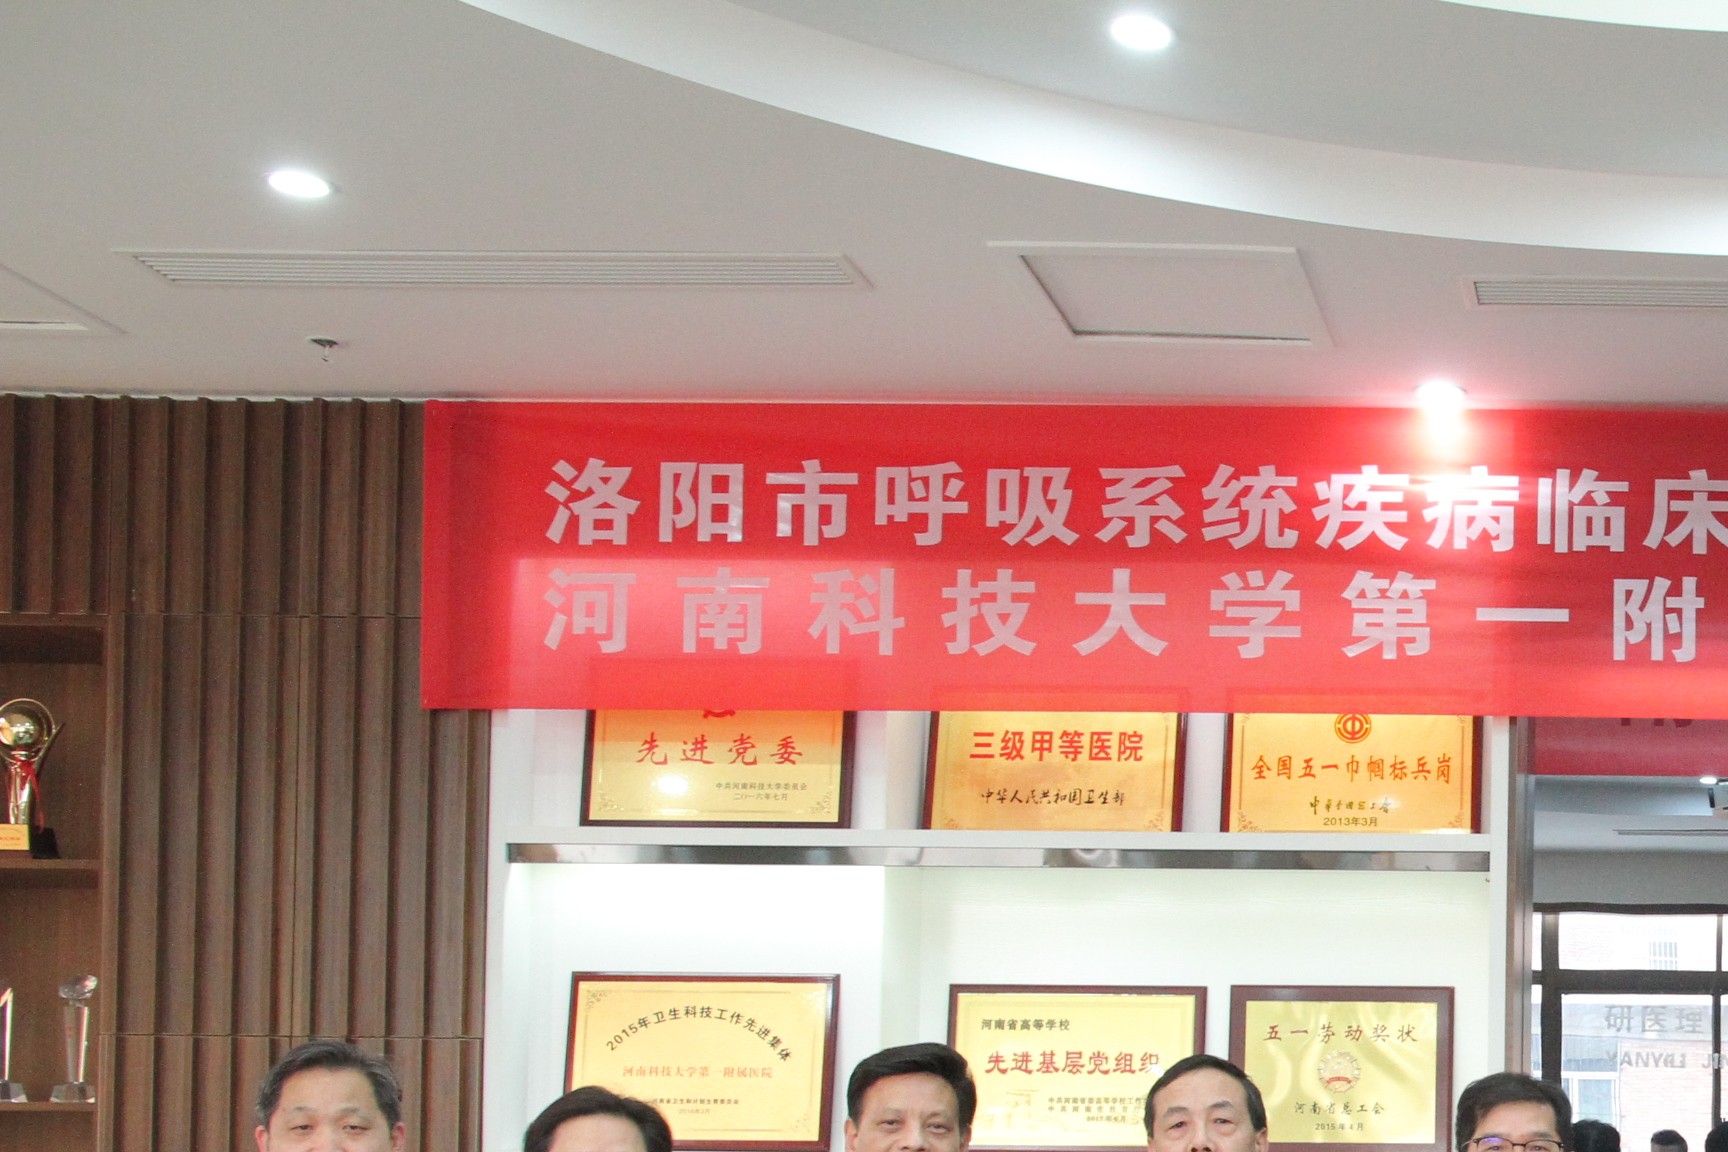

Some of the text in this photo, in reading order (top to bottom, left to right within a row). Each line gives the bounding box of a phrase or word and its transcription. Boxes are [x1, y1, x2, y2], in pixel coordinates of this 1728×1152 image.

[635, 730, 804, 766] 先进党委
[969, 729, 1144, 762] 三级甲等医院
[1250, 752, 1452, 784] 全国五一巾帼标兵岗
[981, 788, 1126, 806] 中华人民共和国卫生部
[1322, 816, 1378, 828] 2013年3月
[980, 1018, 1071, 1031] 河南省高等学校
[1603, 1004, 1704, 1034] 研医理
[605, 1004, 793, 1063] 2015年卫生科技工作先进集体
[1262, 1022, 1419, 1044] 五一劳动奖状
[622, 1064, 774, 1079] 河南科技大学第一附属医院
[984, 1050, 1160, 1076] 先进基层党组织
[1293, 1101, 1385, 1115] 河南省总工会
